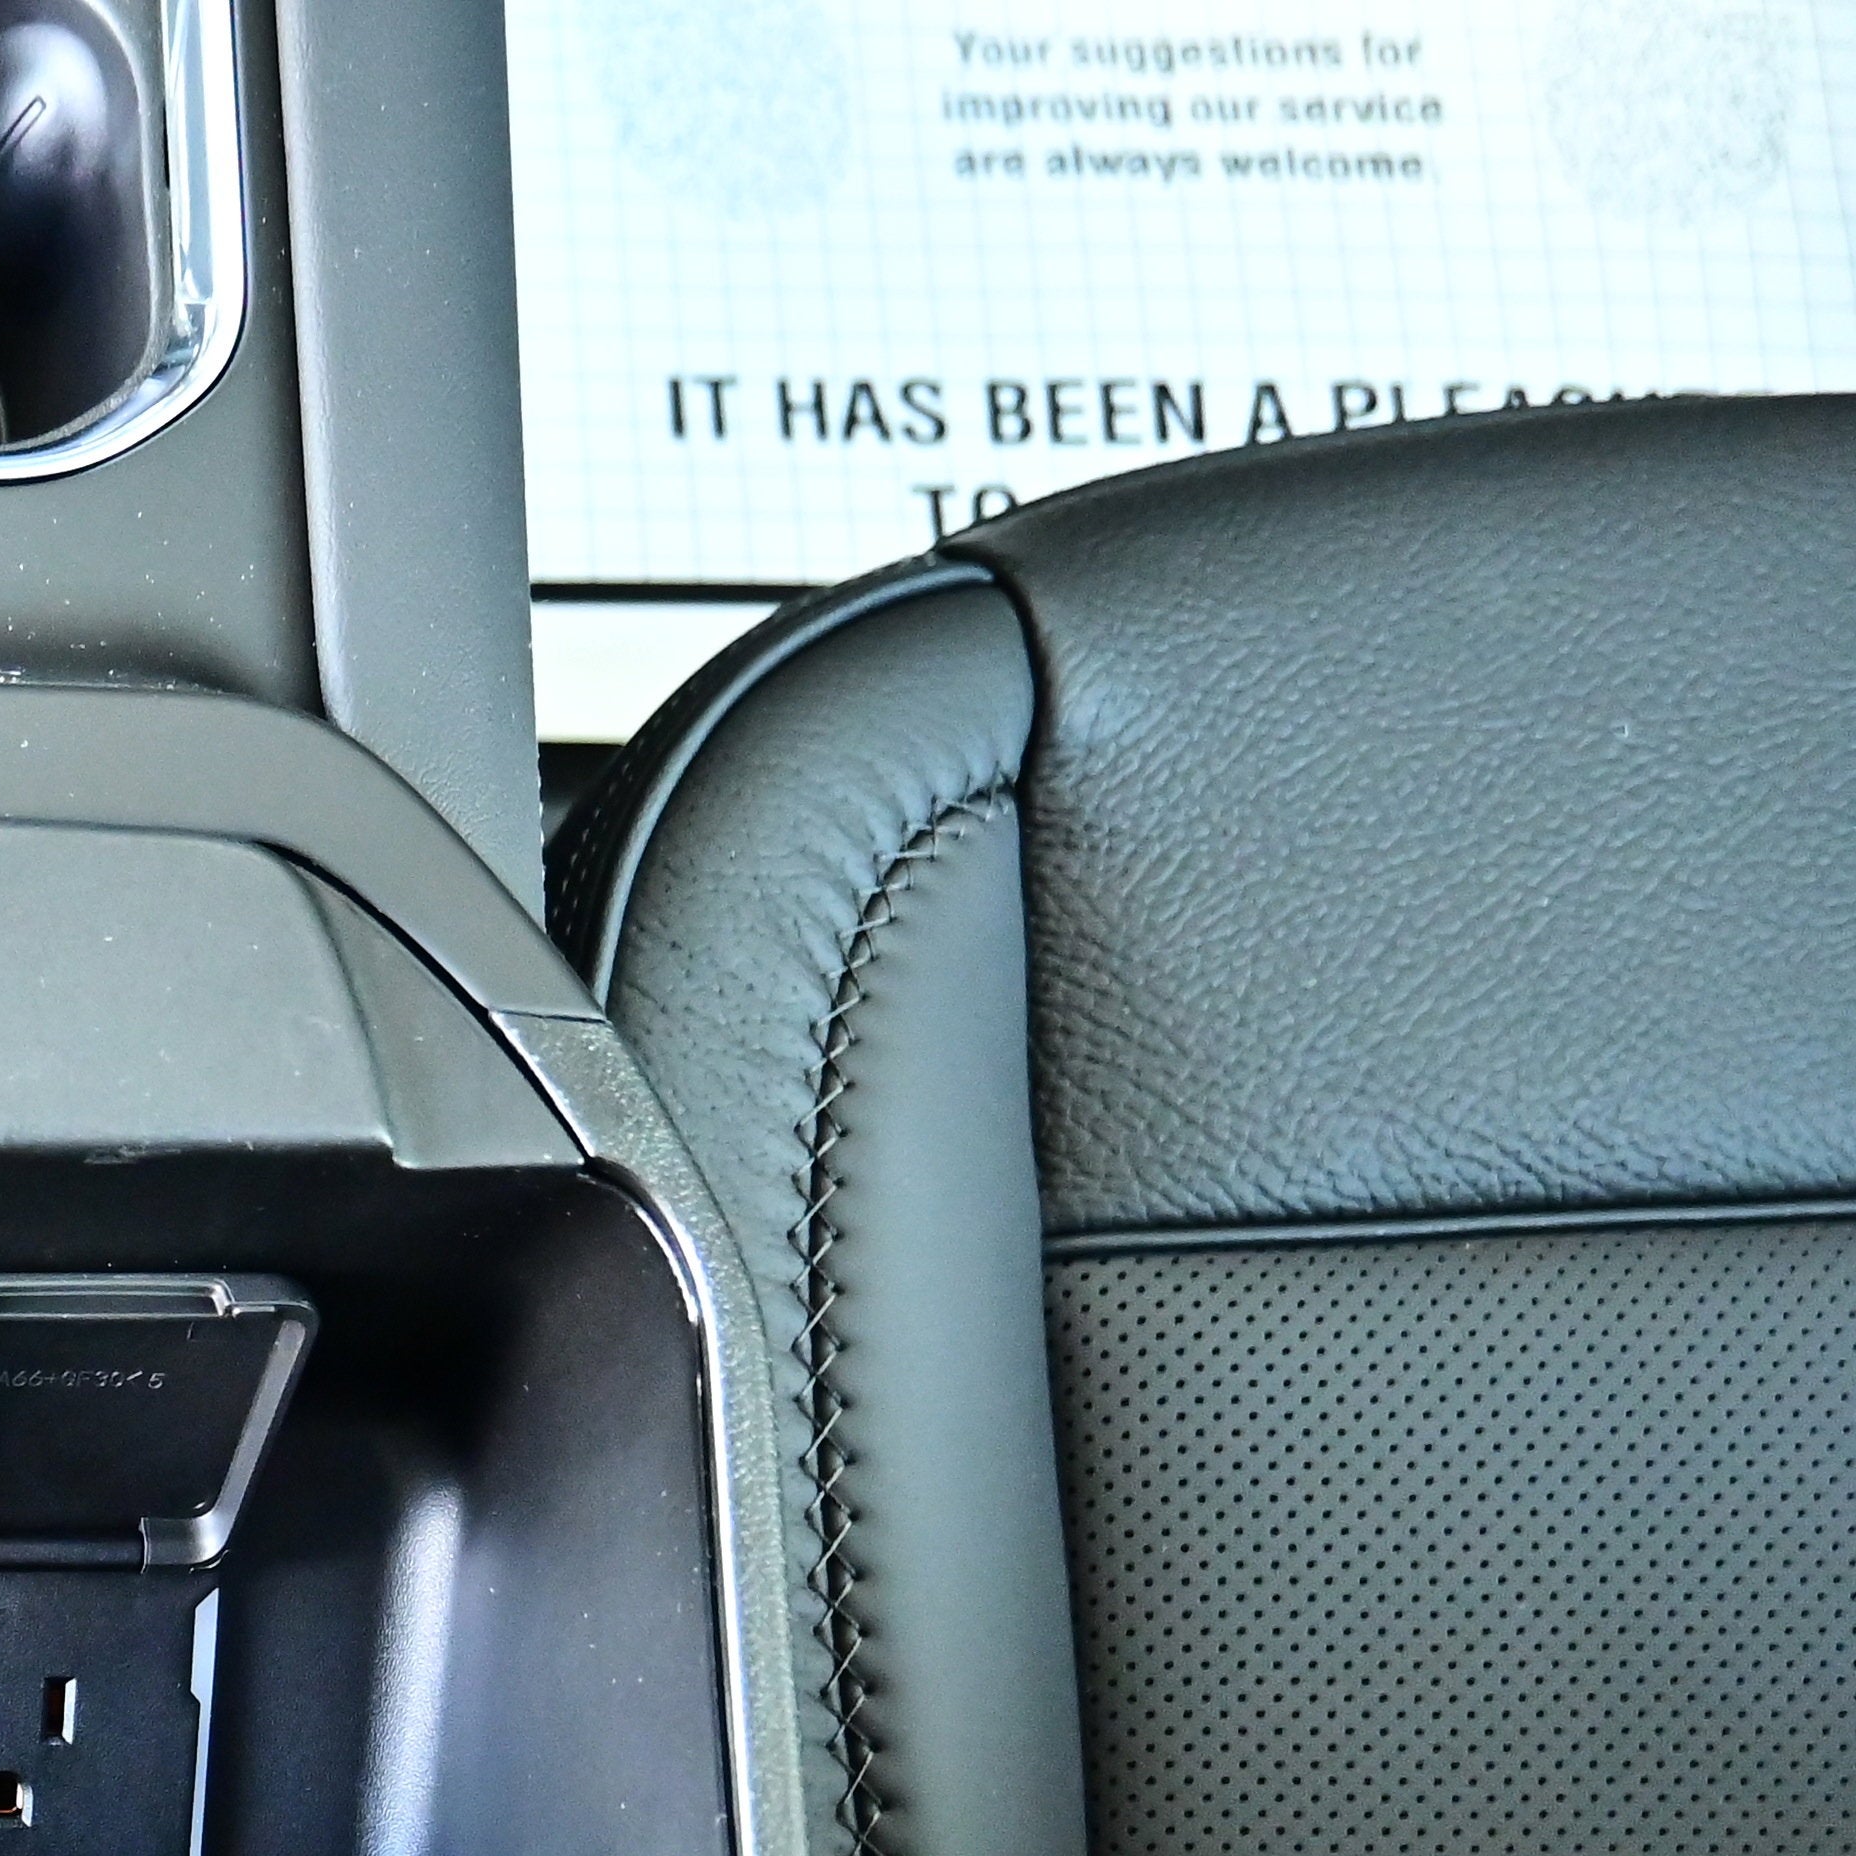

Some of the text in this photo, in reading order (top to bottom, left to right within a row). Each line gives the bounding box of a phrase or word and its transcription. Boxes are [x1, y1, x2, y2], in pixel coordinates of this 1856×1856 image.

[954, 31, 1422, 74] Your suggestions for
[941, 92, 1444, 127] improving our service
[955, 150, 1026, 178] are
[1046, 145, 1201, 182] always
[668, 374, 737, 440] IT
[778, 377, 947, 442] HAS
[987, 379, 1205, 444] BEEN
[1245, 382, 1293, 444] A
